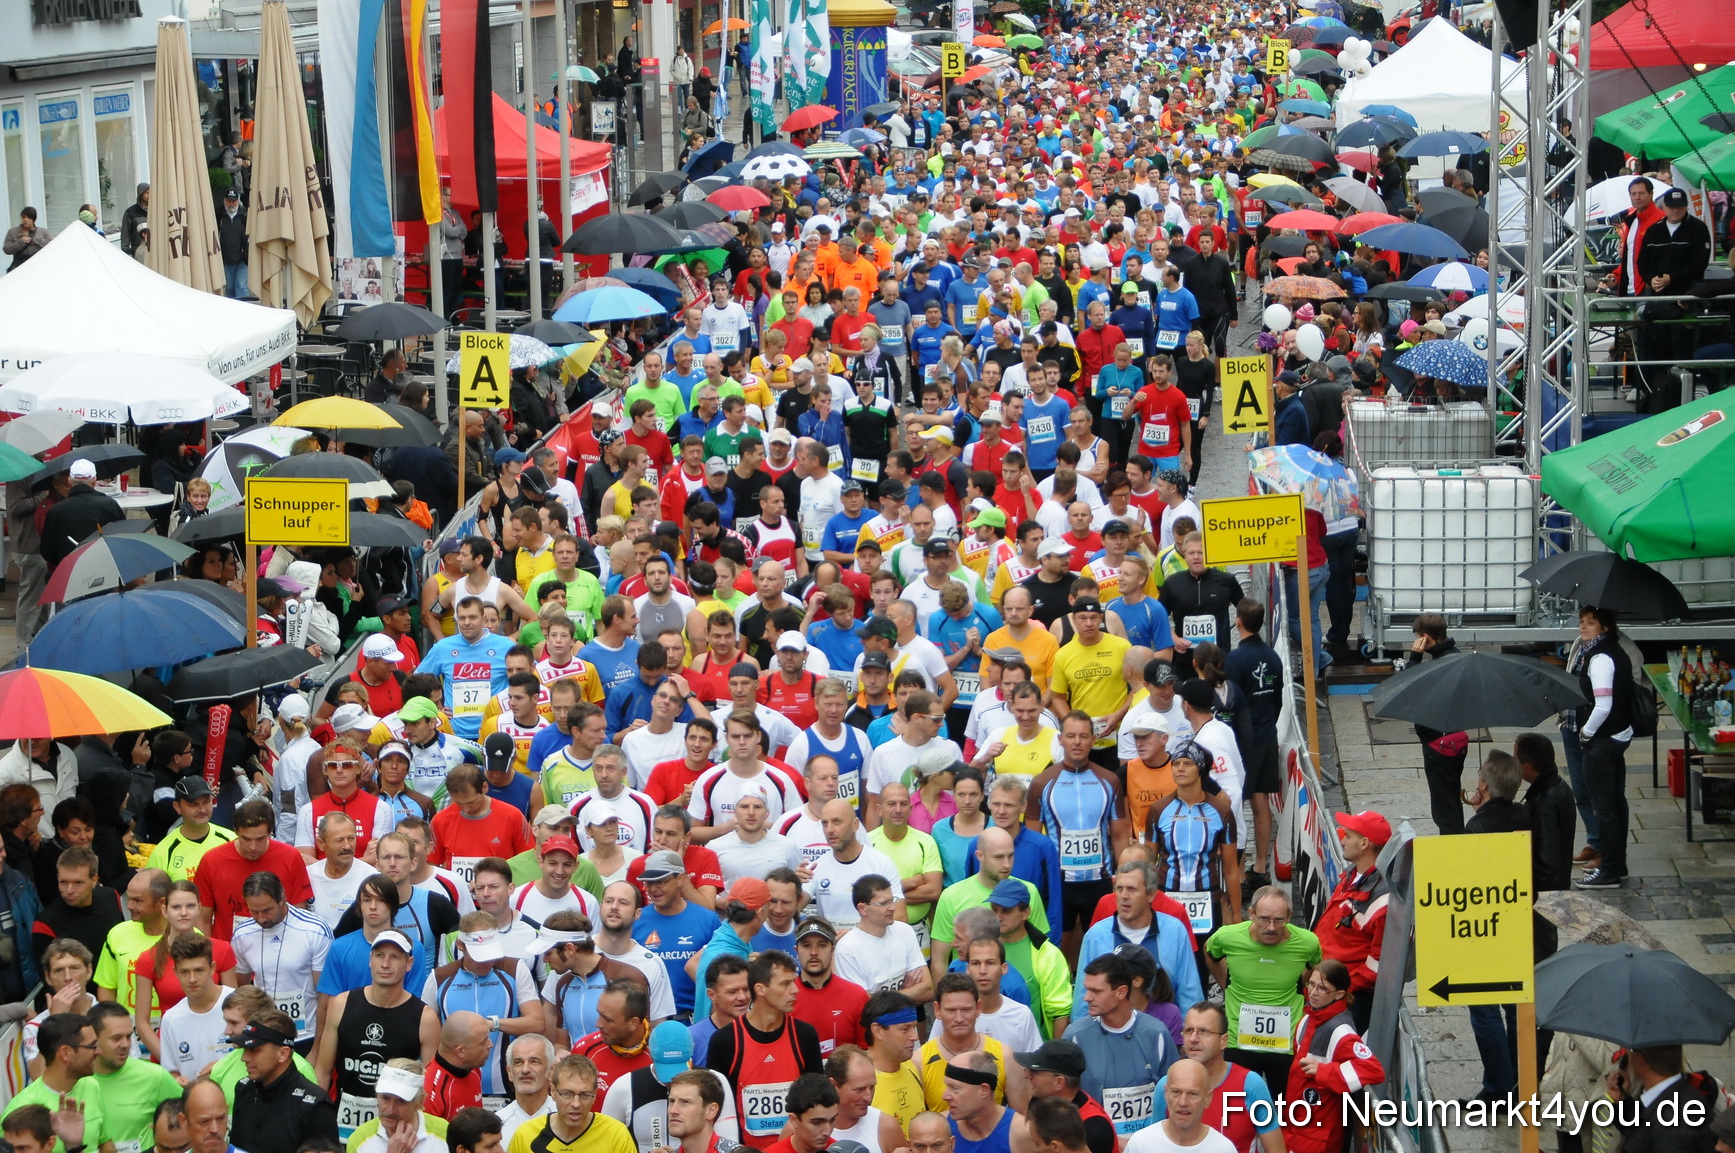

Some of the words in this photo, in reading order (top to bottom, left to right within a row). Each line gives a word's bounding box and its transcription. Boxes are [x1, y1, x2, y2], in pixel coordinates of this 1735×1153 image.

[944, 43, 962, 51] Block
[1270, 40, 1289, 50] Block
[947, 53, 959, 70] B
[1273, 50, 1285, 67] B
[1246, 213, 1260, 222] 2897
[715, 336, 734, 345] 3027
[883, 329, 901, 338] 2856
[1160, 332, 1177, 342] 2767
[465, 335, 504, 350] Block
[217, 360, 233, 376] Von
[267, 338, 281, 354] Audi
[280, 333, 292, 347] BKK
[471, 355, 499, 391] A
[1226, 359, 1266, 375] Block
[1233, 379, 1263, 418] A
[89, 408, 118, 420] BKK
[1029, 422, 1052, 435] 2430
[1145, 429, 1166, 440] 2331
[860, 461, 872, 471] 80
[252, 497, 341, 514] Schnupper-
[282, 516, 312, 529] lauf
[1208, 512, 1297, 533] Schnupper-
[1239, 532, 1268, 548] lauf
[965, 554, 982, 563] MAX
[1184, 623, 1213, 637] 3048
[453, 662, 490, 680] Lete
[463, 690, 479, 704] 37
[463, 705, 479, 713] Dieter
[206, 746, 218, 771] BKK
[560, 783, 590, 792] TEAM
[837, 782, 856, 799] 09
[1064, 838, 1099, 855] 2196
[1072, 857, 1092, 865] Gerald
[1418, 878, 1528, 912] Jugend-
[1450, 911, 1500, 938] lauf
[1241, 1007, 1258, 1015] PARTL
[1254, 1016, 1276, 1035] 50
[1251, 1036, 1276, 1047] Oswald
[743, 1088, 762, 1096] PARTL
[1104, 1092, 1123, 1100] PARTL
[1110, 1095, 1153, 1121] 2672
[652, 1118, 661, 1140] Roth
[759, 1119, 784, 1129] Stefan
